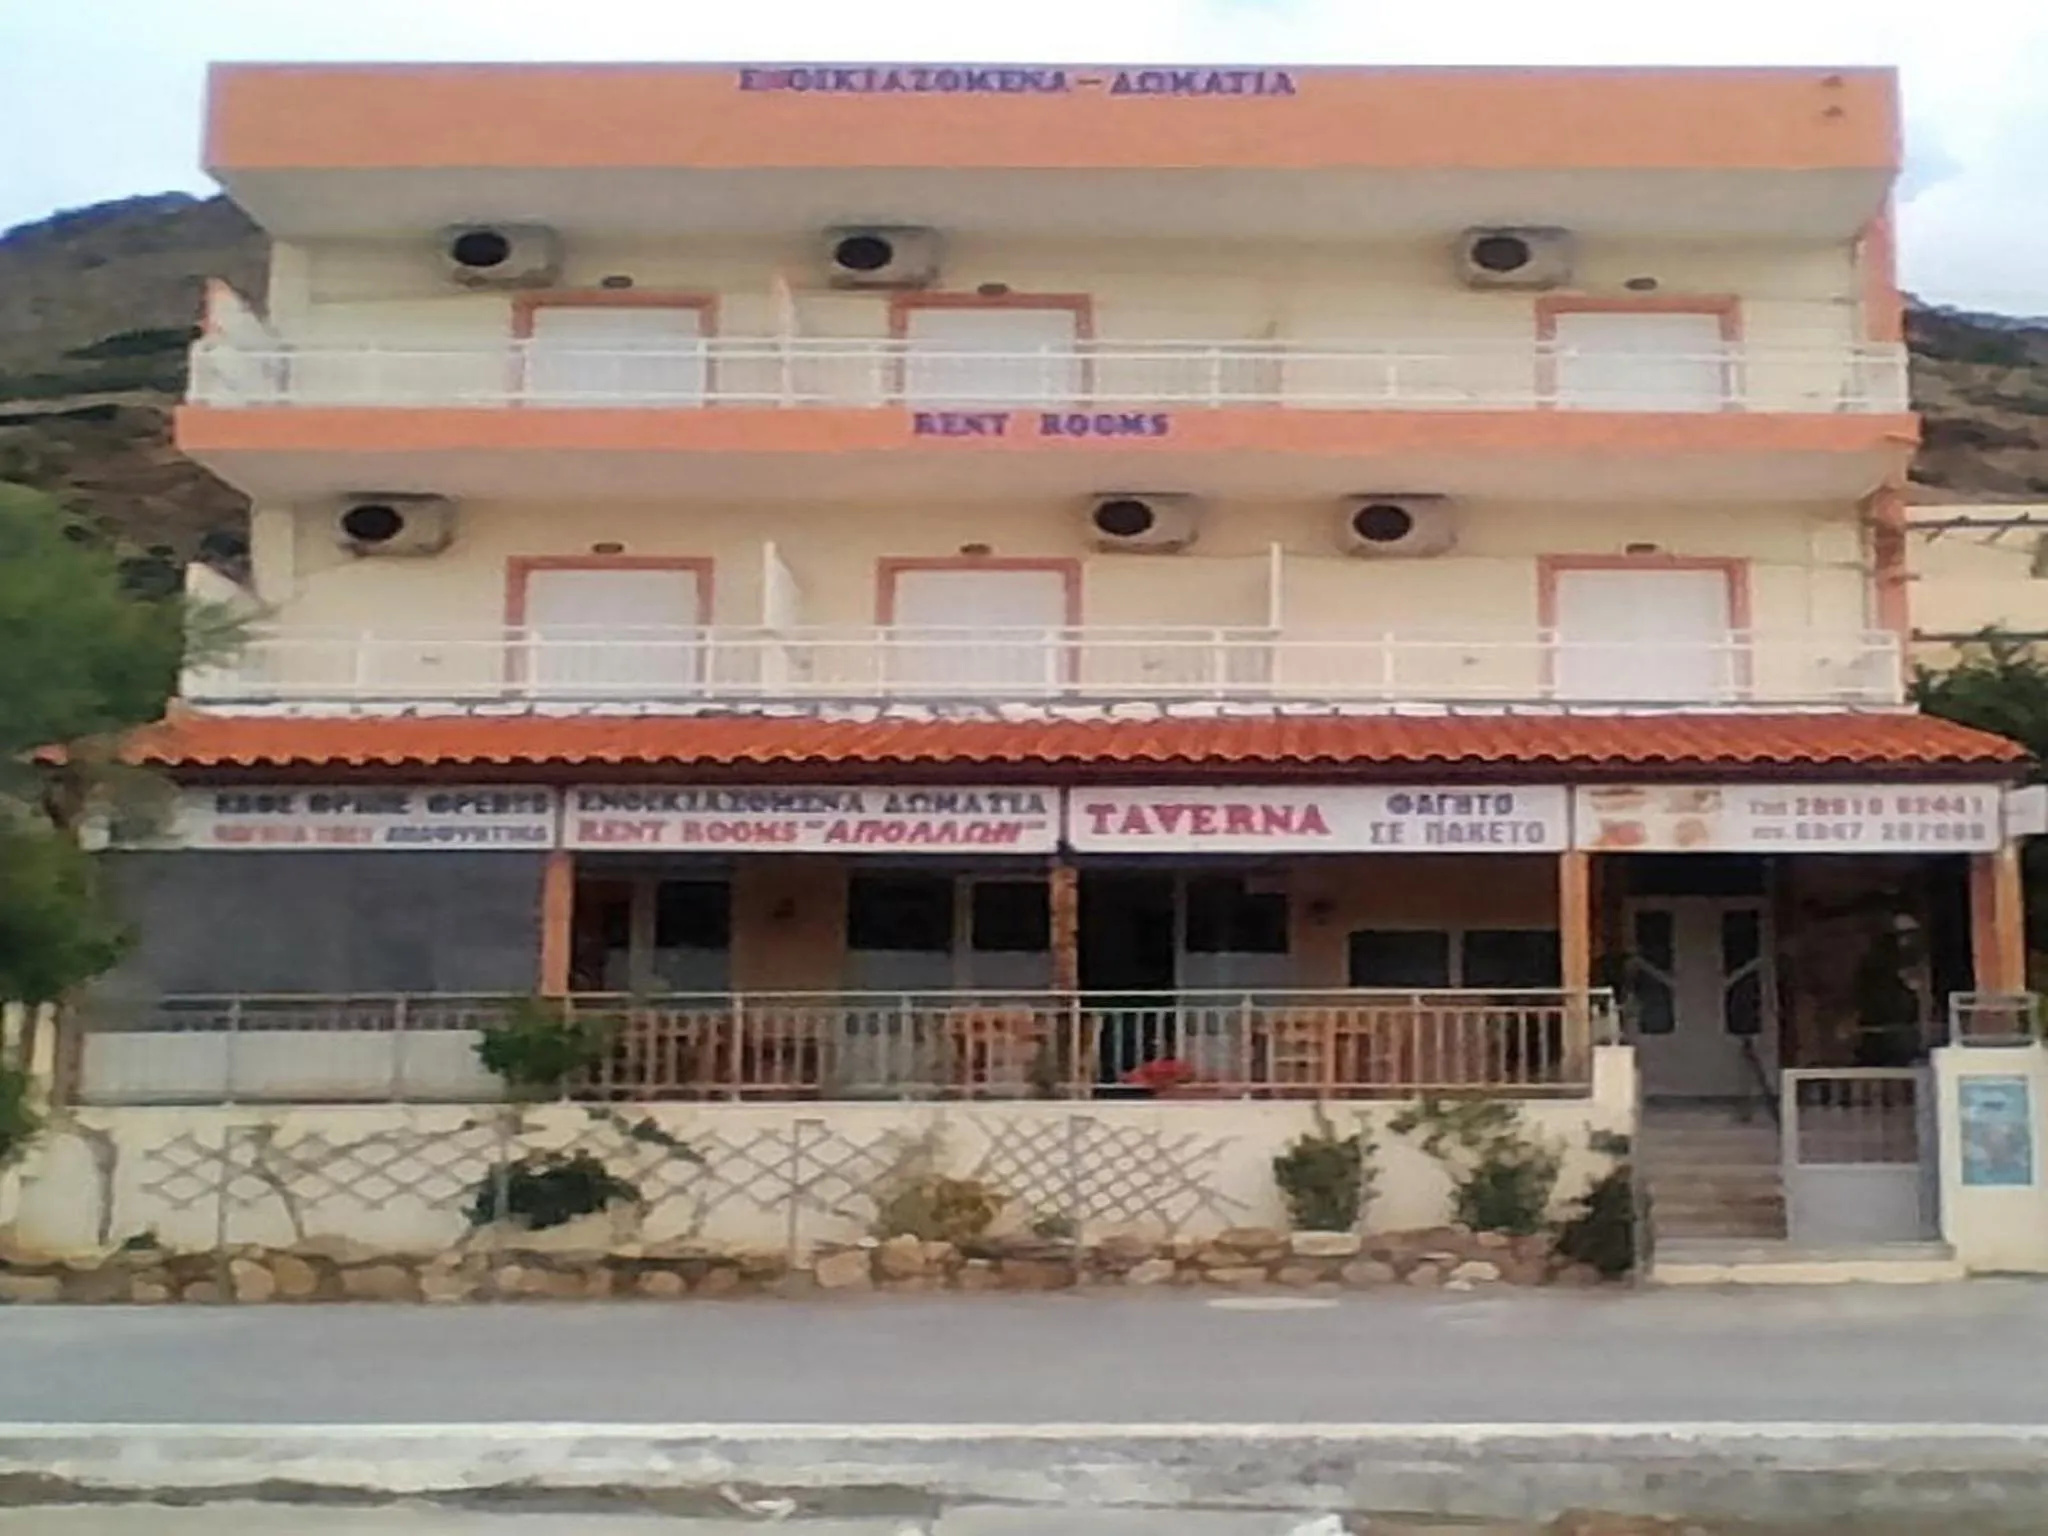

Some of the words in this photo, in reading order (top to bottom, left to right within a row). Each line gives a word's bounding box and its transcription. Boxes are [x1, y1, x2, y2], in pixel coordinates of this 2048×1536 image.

[739, 68, 1070, 93] ΕΟΙΚΙΑΖΟΜΕΝΑ
[1109, 70, 1297, 95] ΔΩΜΑΤΙΑ
[913, 411, 1010, 436] RENT
[1038, 412, 1170, 437] ROOMS
[883, 790, 1049, 815] ΔΩΜΑΤΙΑ
[1385, 791, 1515, 817] ΦΑΓΗΤΟ
[577, 818, 668, 843] RENT
[681, 819, 798, 844] ROOMS
[1084, 802, 1332, 837] TAVERNA
[1369, 820, 1408, 845] ΣΕ
[1424, 820, 1546, 845] ΠΑΚΕΤΟ
